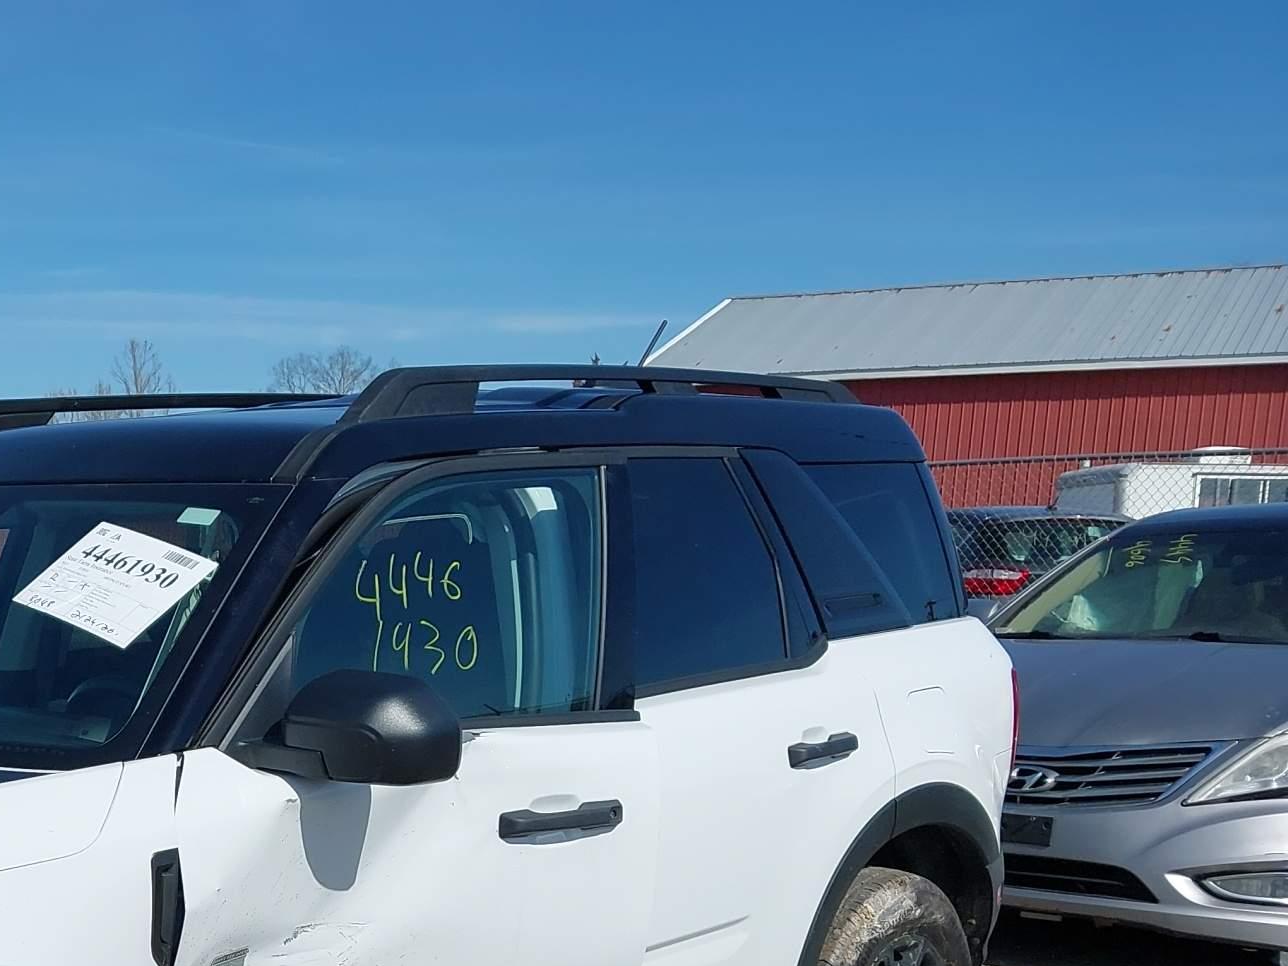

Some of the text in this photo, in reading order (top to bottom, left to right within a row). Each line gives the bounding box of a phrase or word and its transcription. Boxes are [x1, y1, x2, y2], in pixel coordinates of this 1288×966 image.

[81, 544, 179, 590] 44461930
[355, 551, 461, 621] 4446
[373, 619, 479, 676] 1930
